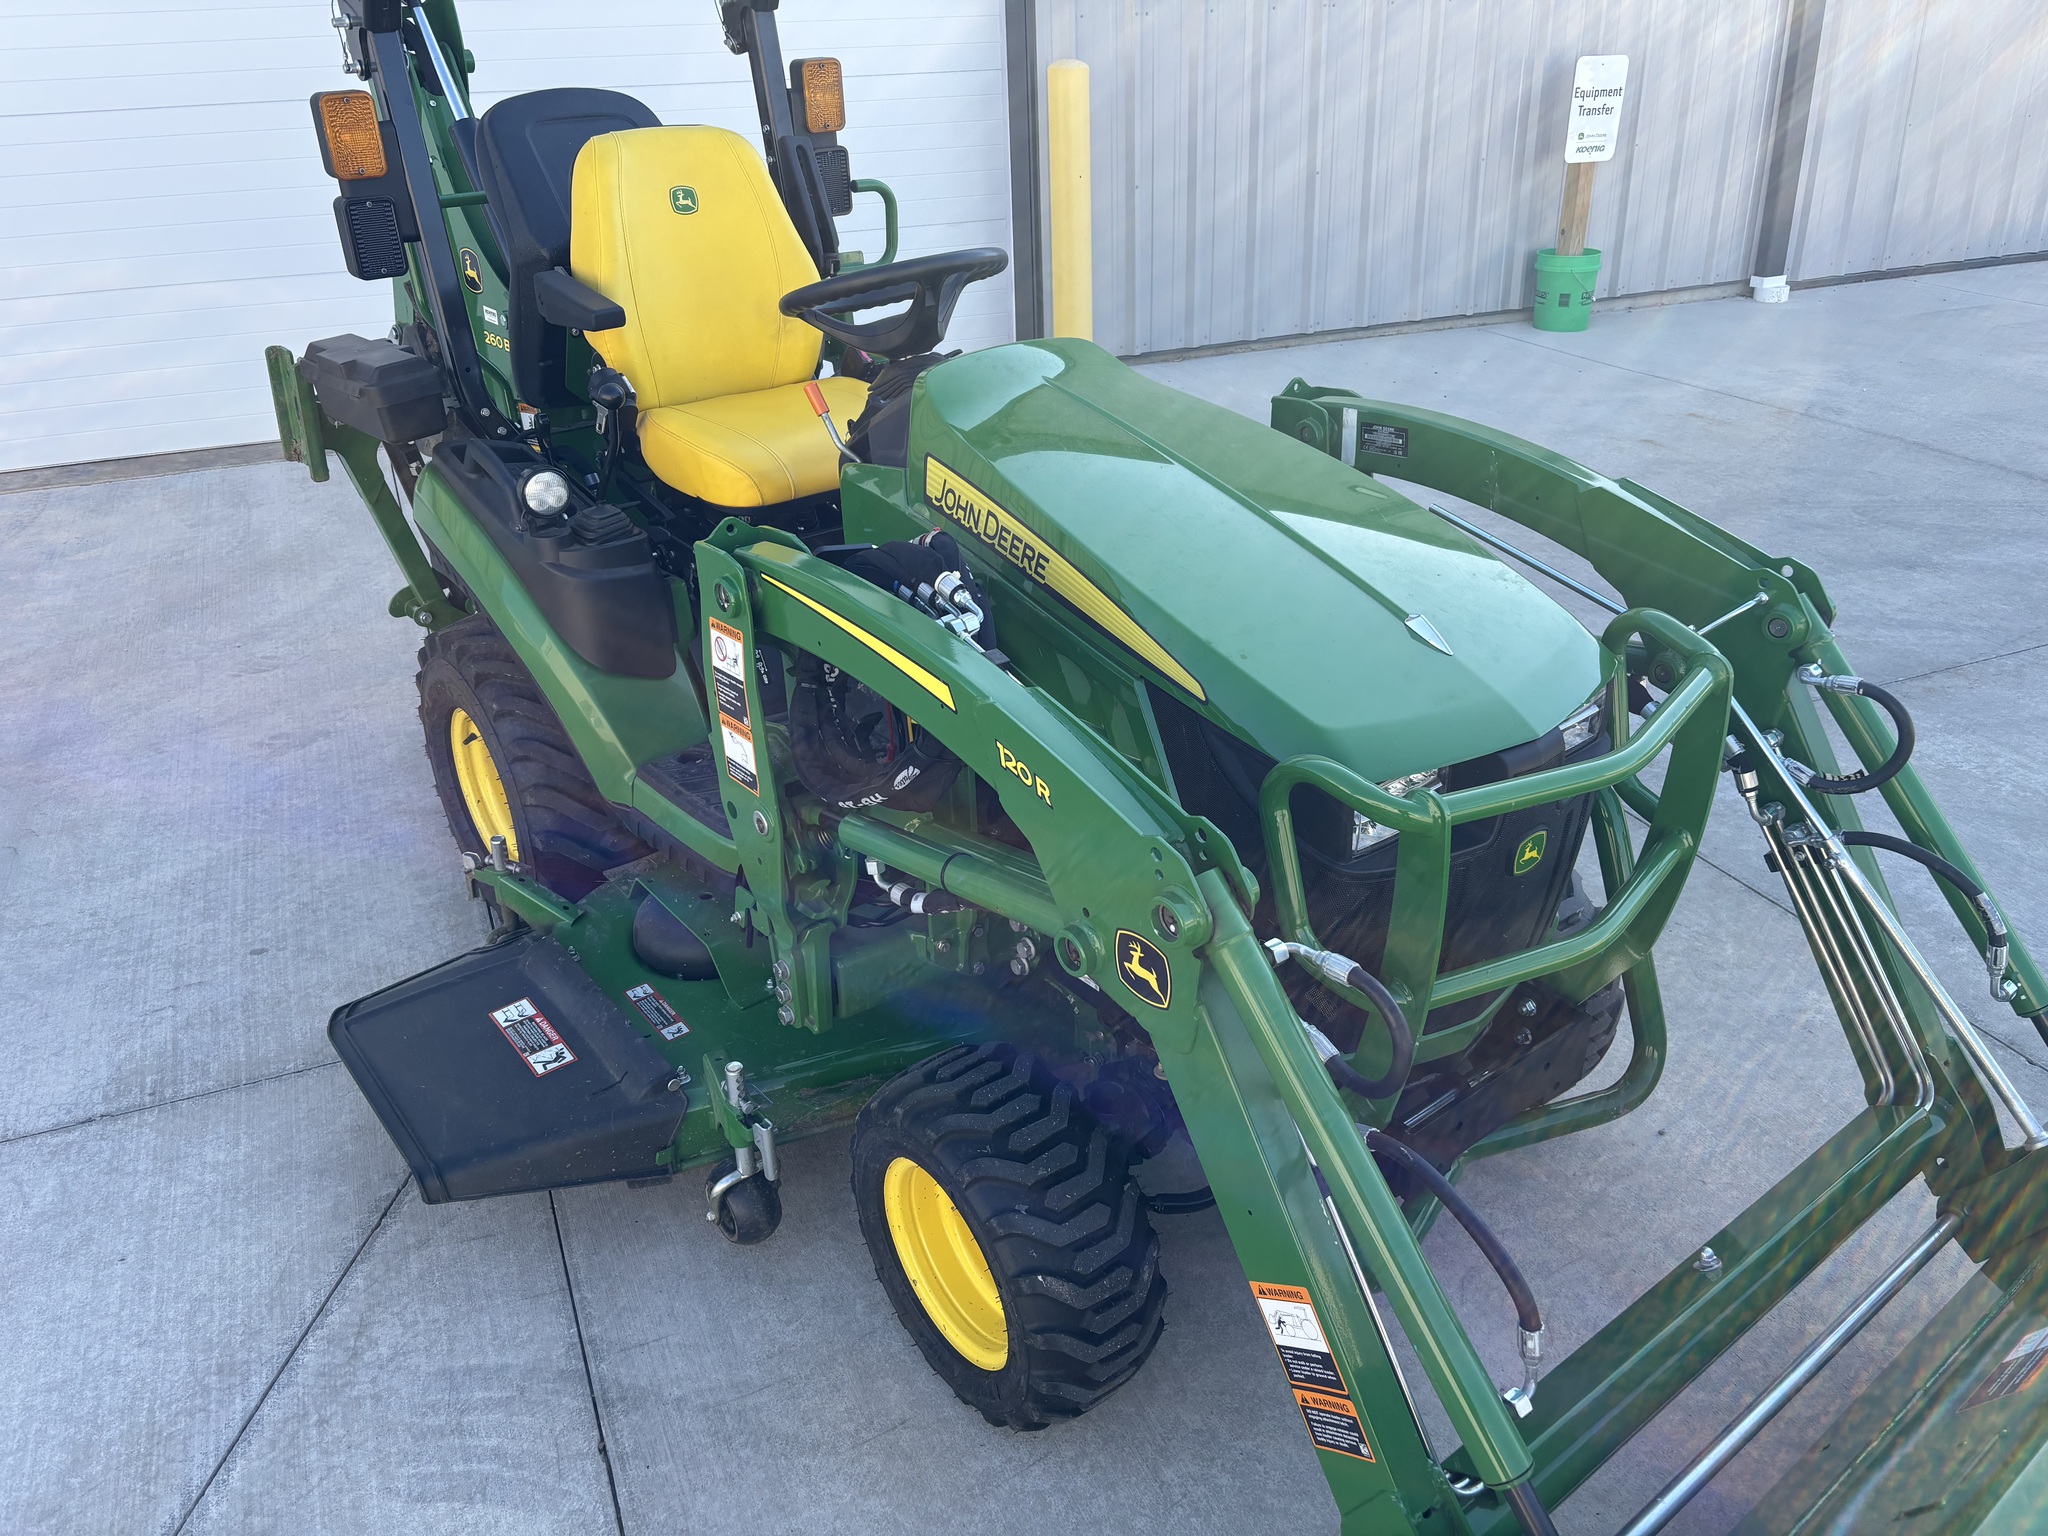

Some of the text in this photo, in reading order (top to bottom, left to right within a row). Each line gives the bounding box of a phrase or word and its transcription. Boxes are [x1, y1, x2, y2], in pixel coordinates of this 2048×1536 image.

[1574, 86, 1623, 101] Equipment
[1578, 104, 1614, 116] Transfer
[484, 331, 502, 349] 260
[935, 478, 1050, 581] JOHN DEERE
[715, 622, 741, 641] WARNING
[726, 720, 750, 740] WARNING
[995, 738, 1054, 810] 120 R
[540, 1021, 559, 1041] DANGER
[1266, 1288, 1304, 1300] WARNING
[1310, 1397, 1349, 1412] WARNING
